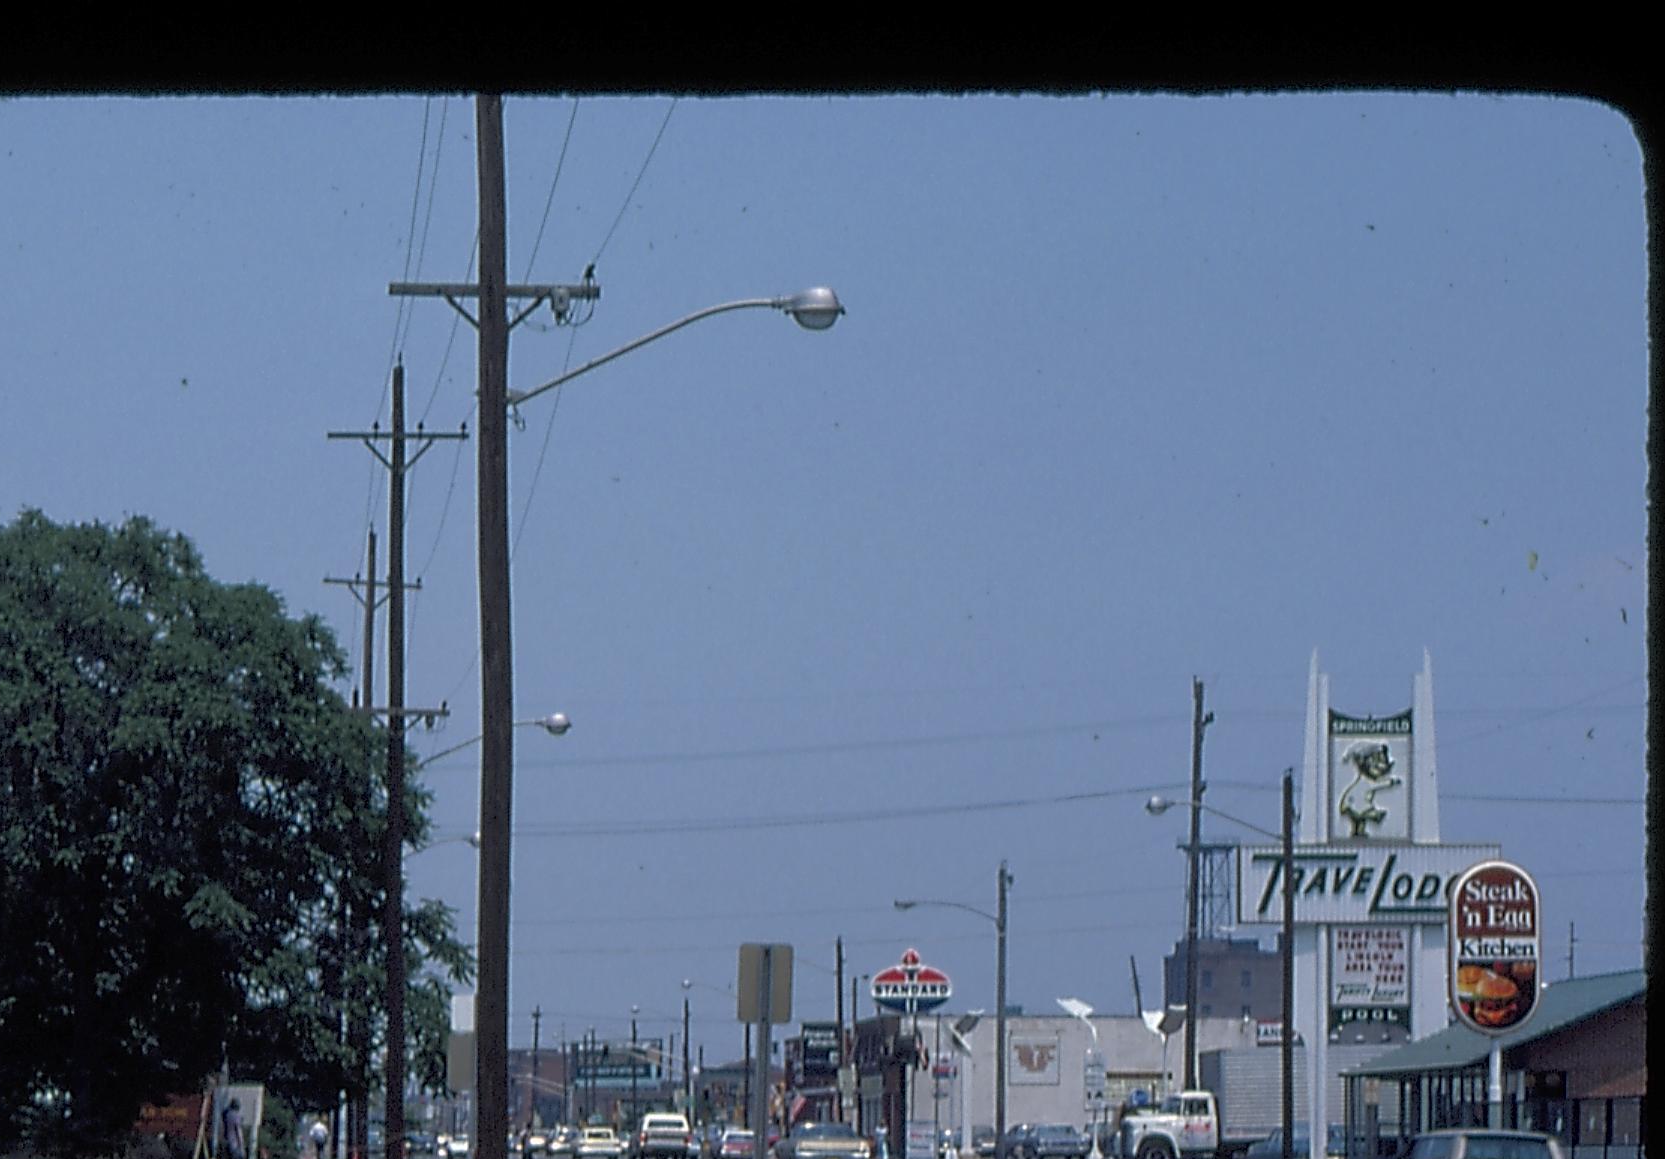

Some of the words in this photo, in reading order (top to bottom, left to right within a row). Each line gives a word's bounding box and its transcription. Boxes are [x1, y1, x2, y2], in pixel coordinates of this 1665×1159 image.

[1332, 720, 1410, 733] SPRINGFIELD
[1465, 880, 1529, 902] Steak
[1378, 941, 1404, 951] YOUR
[1460, 937, 1535, 957] Kitchen
[876, 984, 948, 994] STANDARD
[1342, 1009, 1398, 1020] POOL
